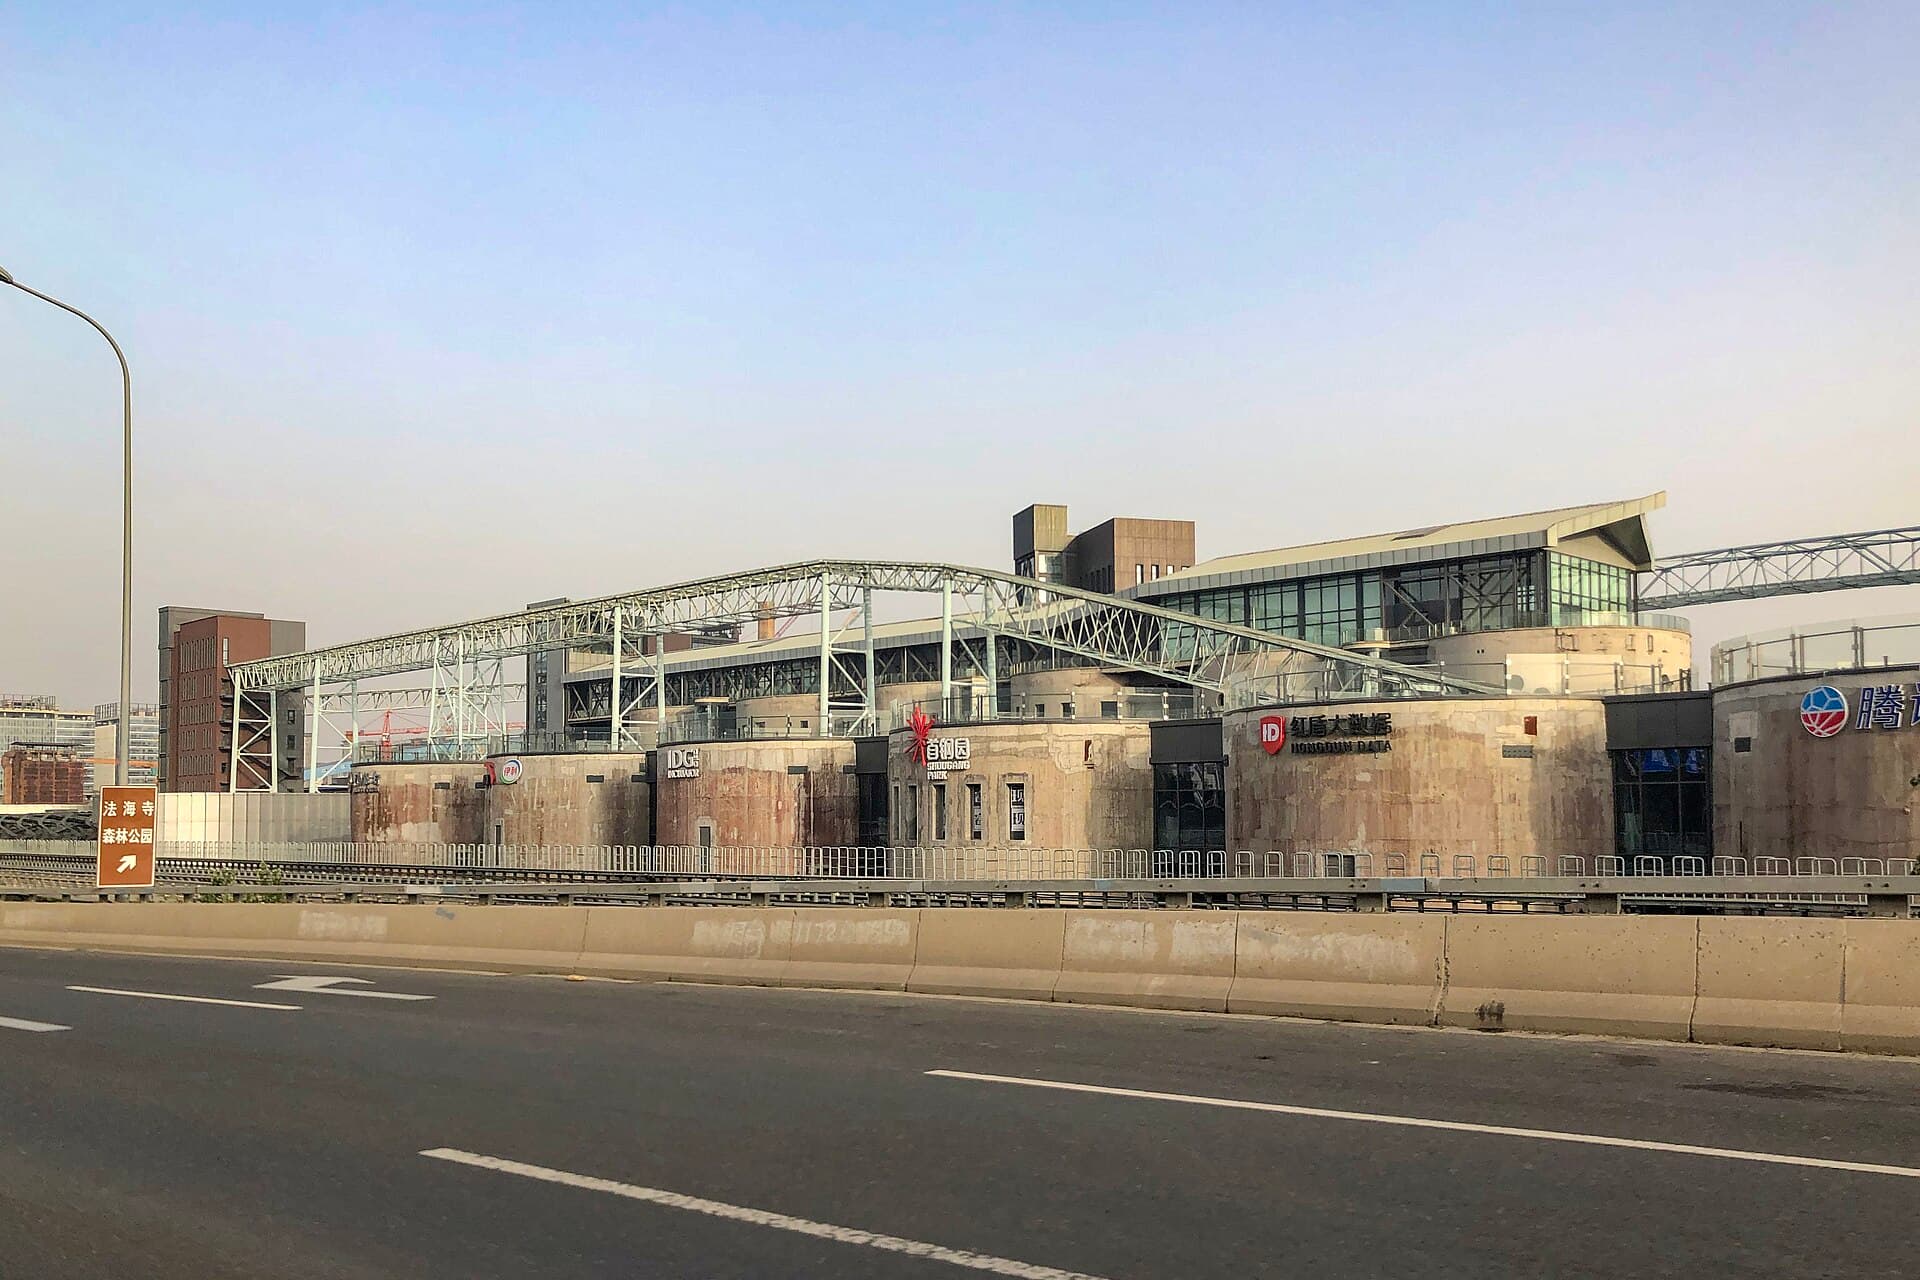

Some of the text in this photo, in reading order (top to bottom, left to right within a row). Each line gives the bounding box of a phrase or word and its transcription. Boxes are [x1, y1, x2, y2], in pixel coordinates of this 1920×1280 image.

[1290, 712, 1392, 737] 红盾大数据
[927, 738, 970, 760] 首钢园
[1291, 740, 1392, 753] HONGDUN DATA
[668, 749, 694, 768] IDG
[927, 761, 970, 770] SHOUGANG
[928, 771, 948, 779] PARK
[103, 800, 154, 817] 法海寺
[102, 828, 153, 844] 森林公园
